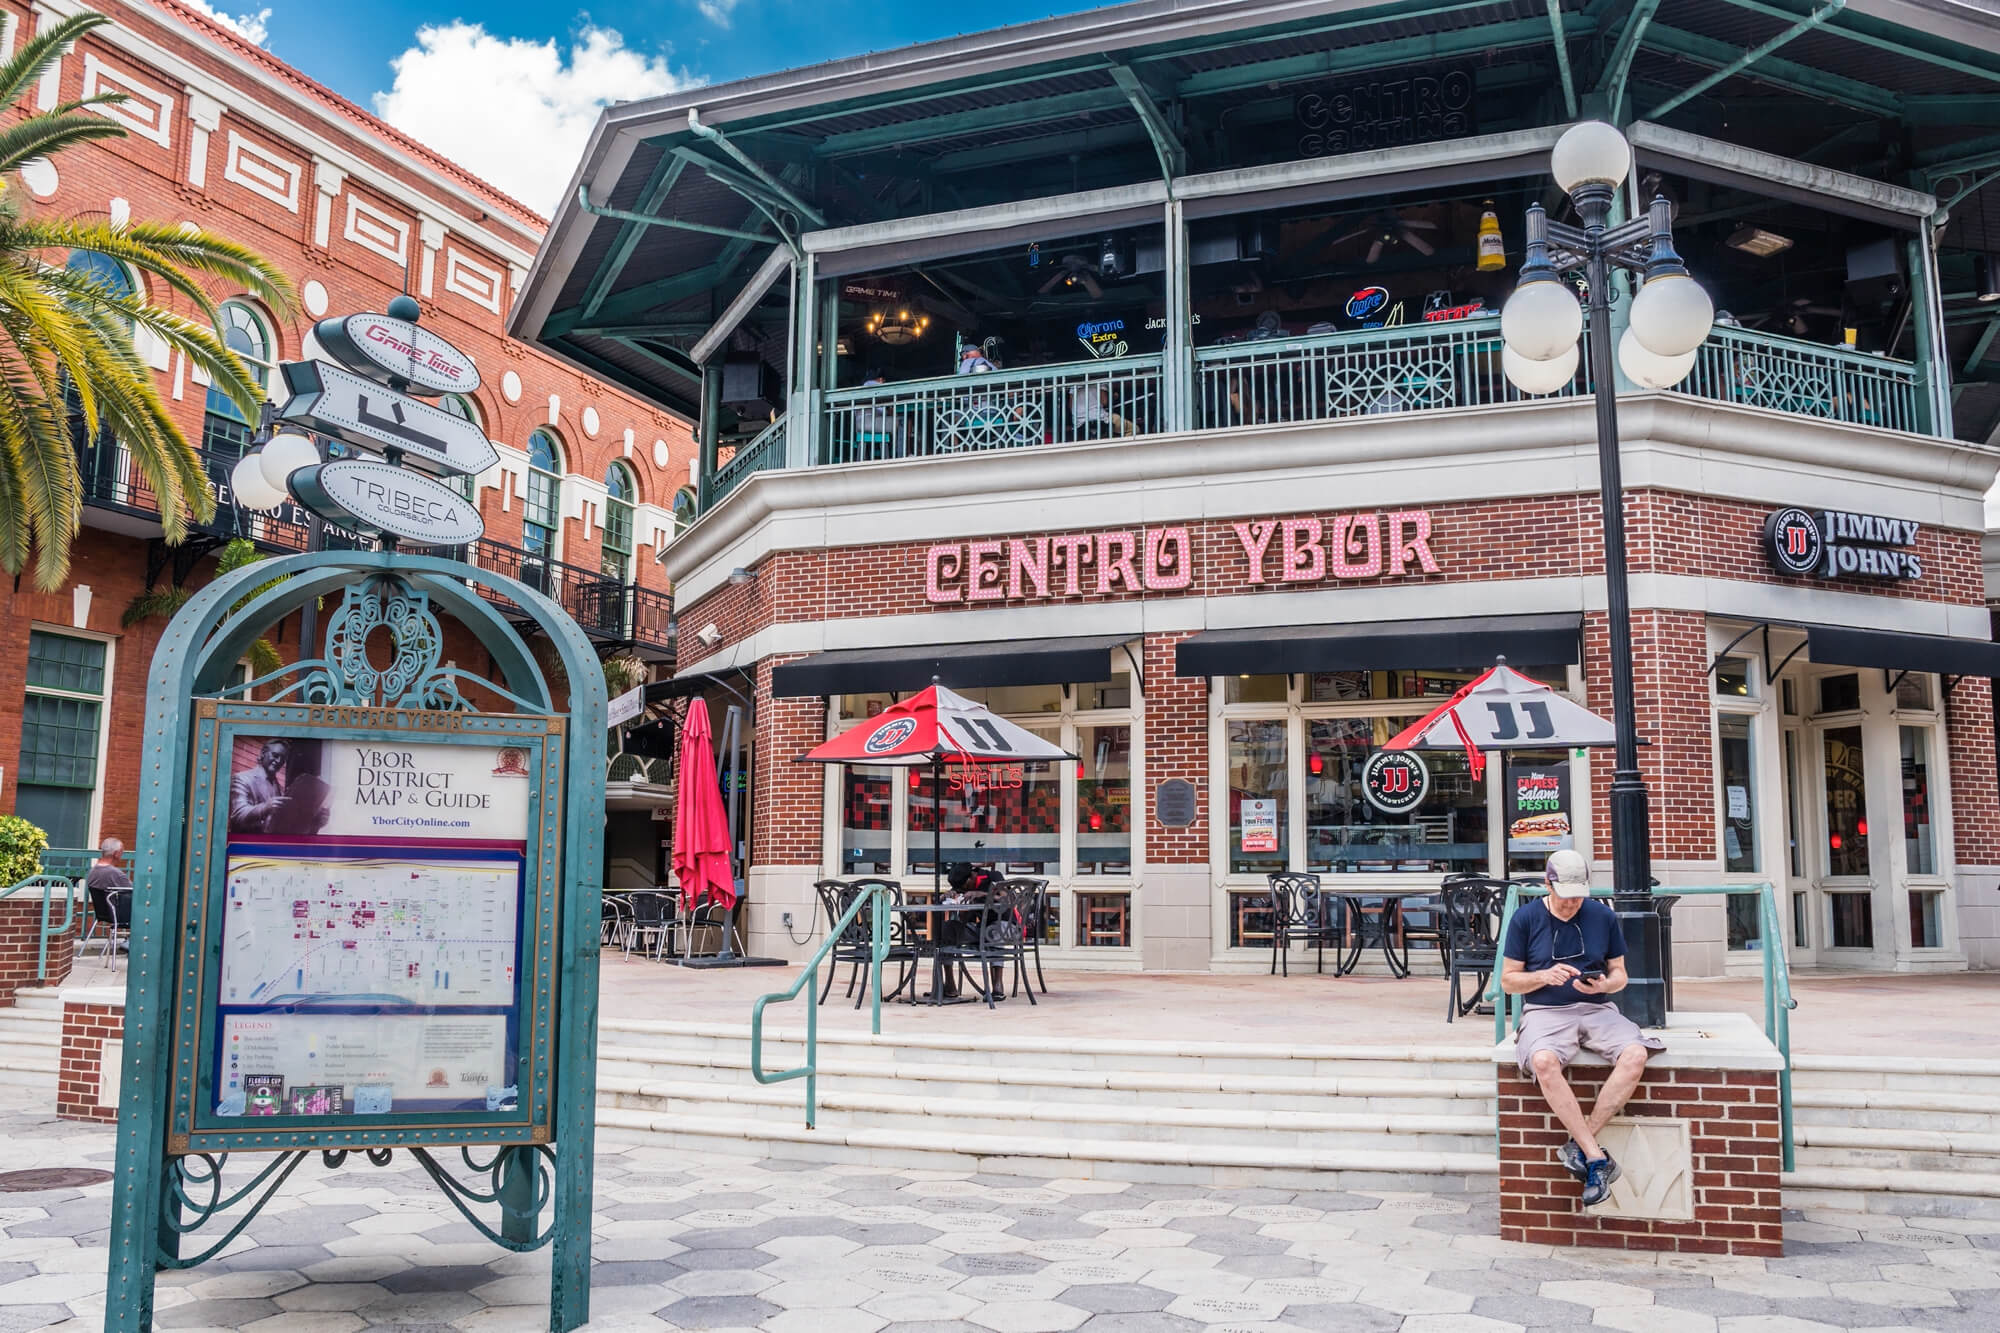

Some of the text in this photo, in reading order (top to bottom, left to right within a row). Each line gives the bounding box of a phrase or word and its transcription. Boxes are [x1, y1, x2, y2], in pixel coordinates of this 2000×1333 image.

[1077, 319, 1124, 339] Corona
[1092, 332, 1117, 343] Extra
[350, 476, 459, 526] TRIBECA
[1824, 511, 1919, 545] JIMMY
[1787, 526, 1806, 555] JJ
[926, 510, 1442, 602] CENTRO YBOR
[1826, 545, 1922, 579] JOHN'S
[310, 707, 462, 731] CENTRO YBOR
[1486, 700, 1555, 739] JJ
[356, 748, 415, 768] YBOR
[1371, 754, 1420, 776] JIMMY JOHN'S
[357, 768, 454, 789] DISTRICT
[950, 768, 1023, 790] SMELLS
[1382, 767, 1409, 792] JJ
[1517, 778, 1559, 789] CAPRESE
[355, 787, 491, 809] MAP & GUIDE
[1517, 785, 1559, 800] Salami
[1517, 799, 1559, 811] PESTO
[372, 816, 470, 828] YborCityOnline.com
[234, 1022, 272, 1030] LEGEND
